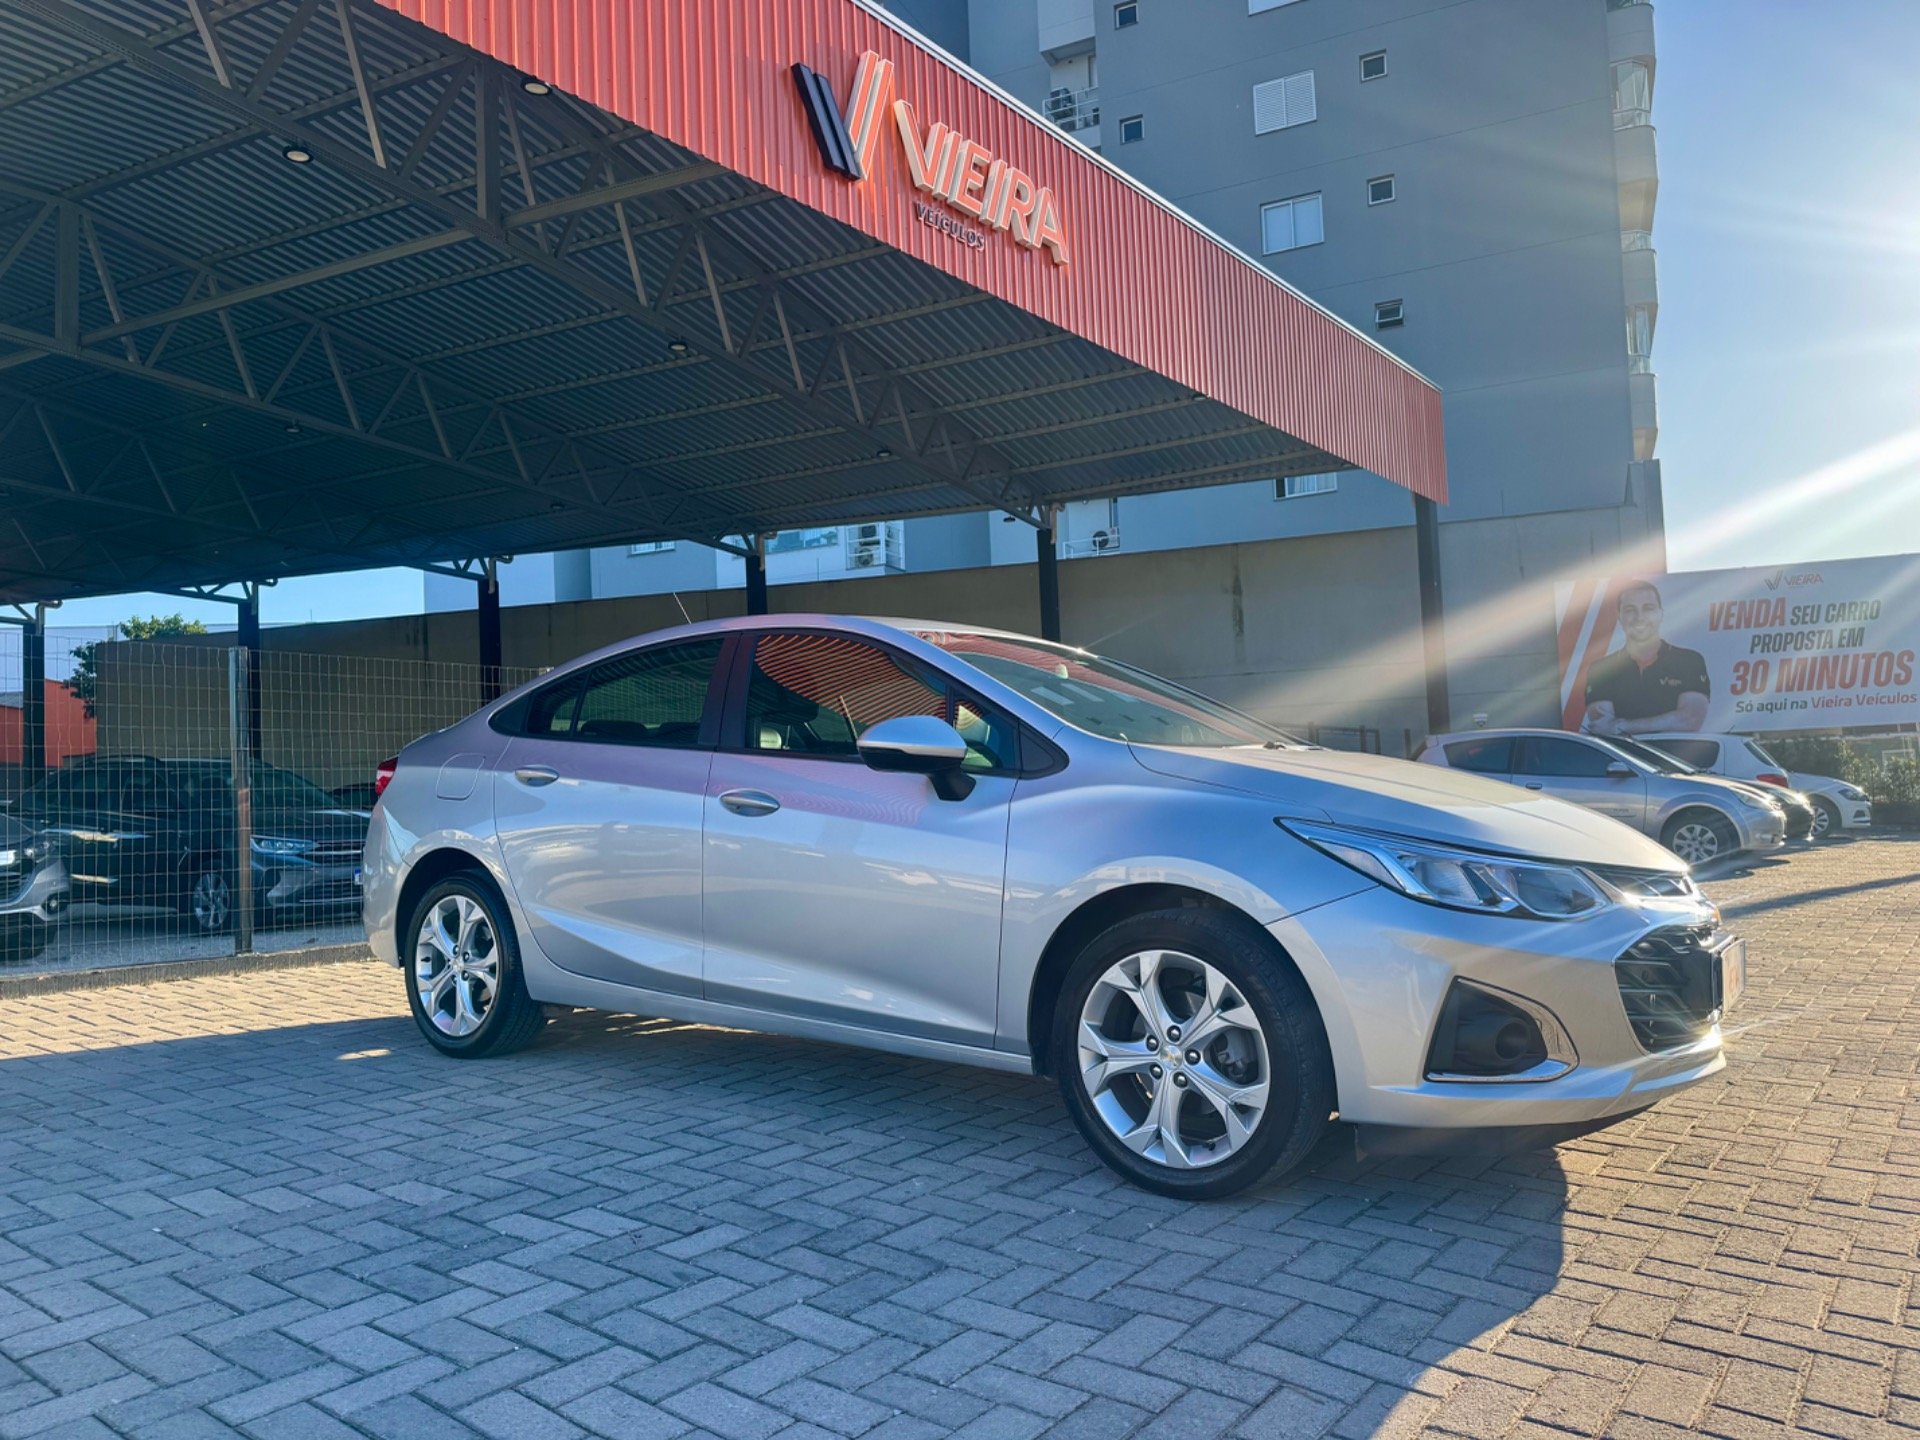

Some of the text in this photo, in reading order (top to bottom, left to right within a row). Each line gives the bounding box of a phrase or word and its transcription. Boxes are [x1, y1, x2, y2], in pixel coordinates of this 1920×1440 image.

[893, 99, 1069, 266] VIEIRA
[914, 201, 985, 251] VEÍCULOS
[1784, 573, 1824, 585] VIEIRA
[1709, 597, 1881, 631] VENDA SEU CARRO
[1750, 627, 1866, 654] PROPOSTA EM
[1730, 649, 1915, 696] 30 MINUTOS
[1736, 692, 1917, 714] Só aqui na Vieira Veículos
